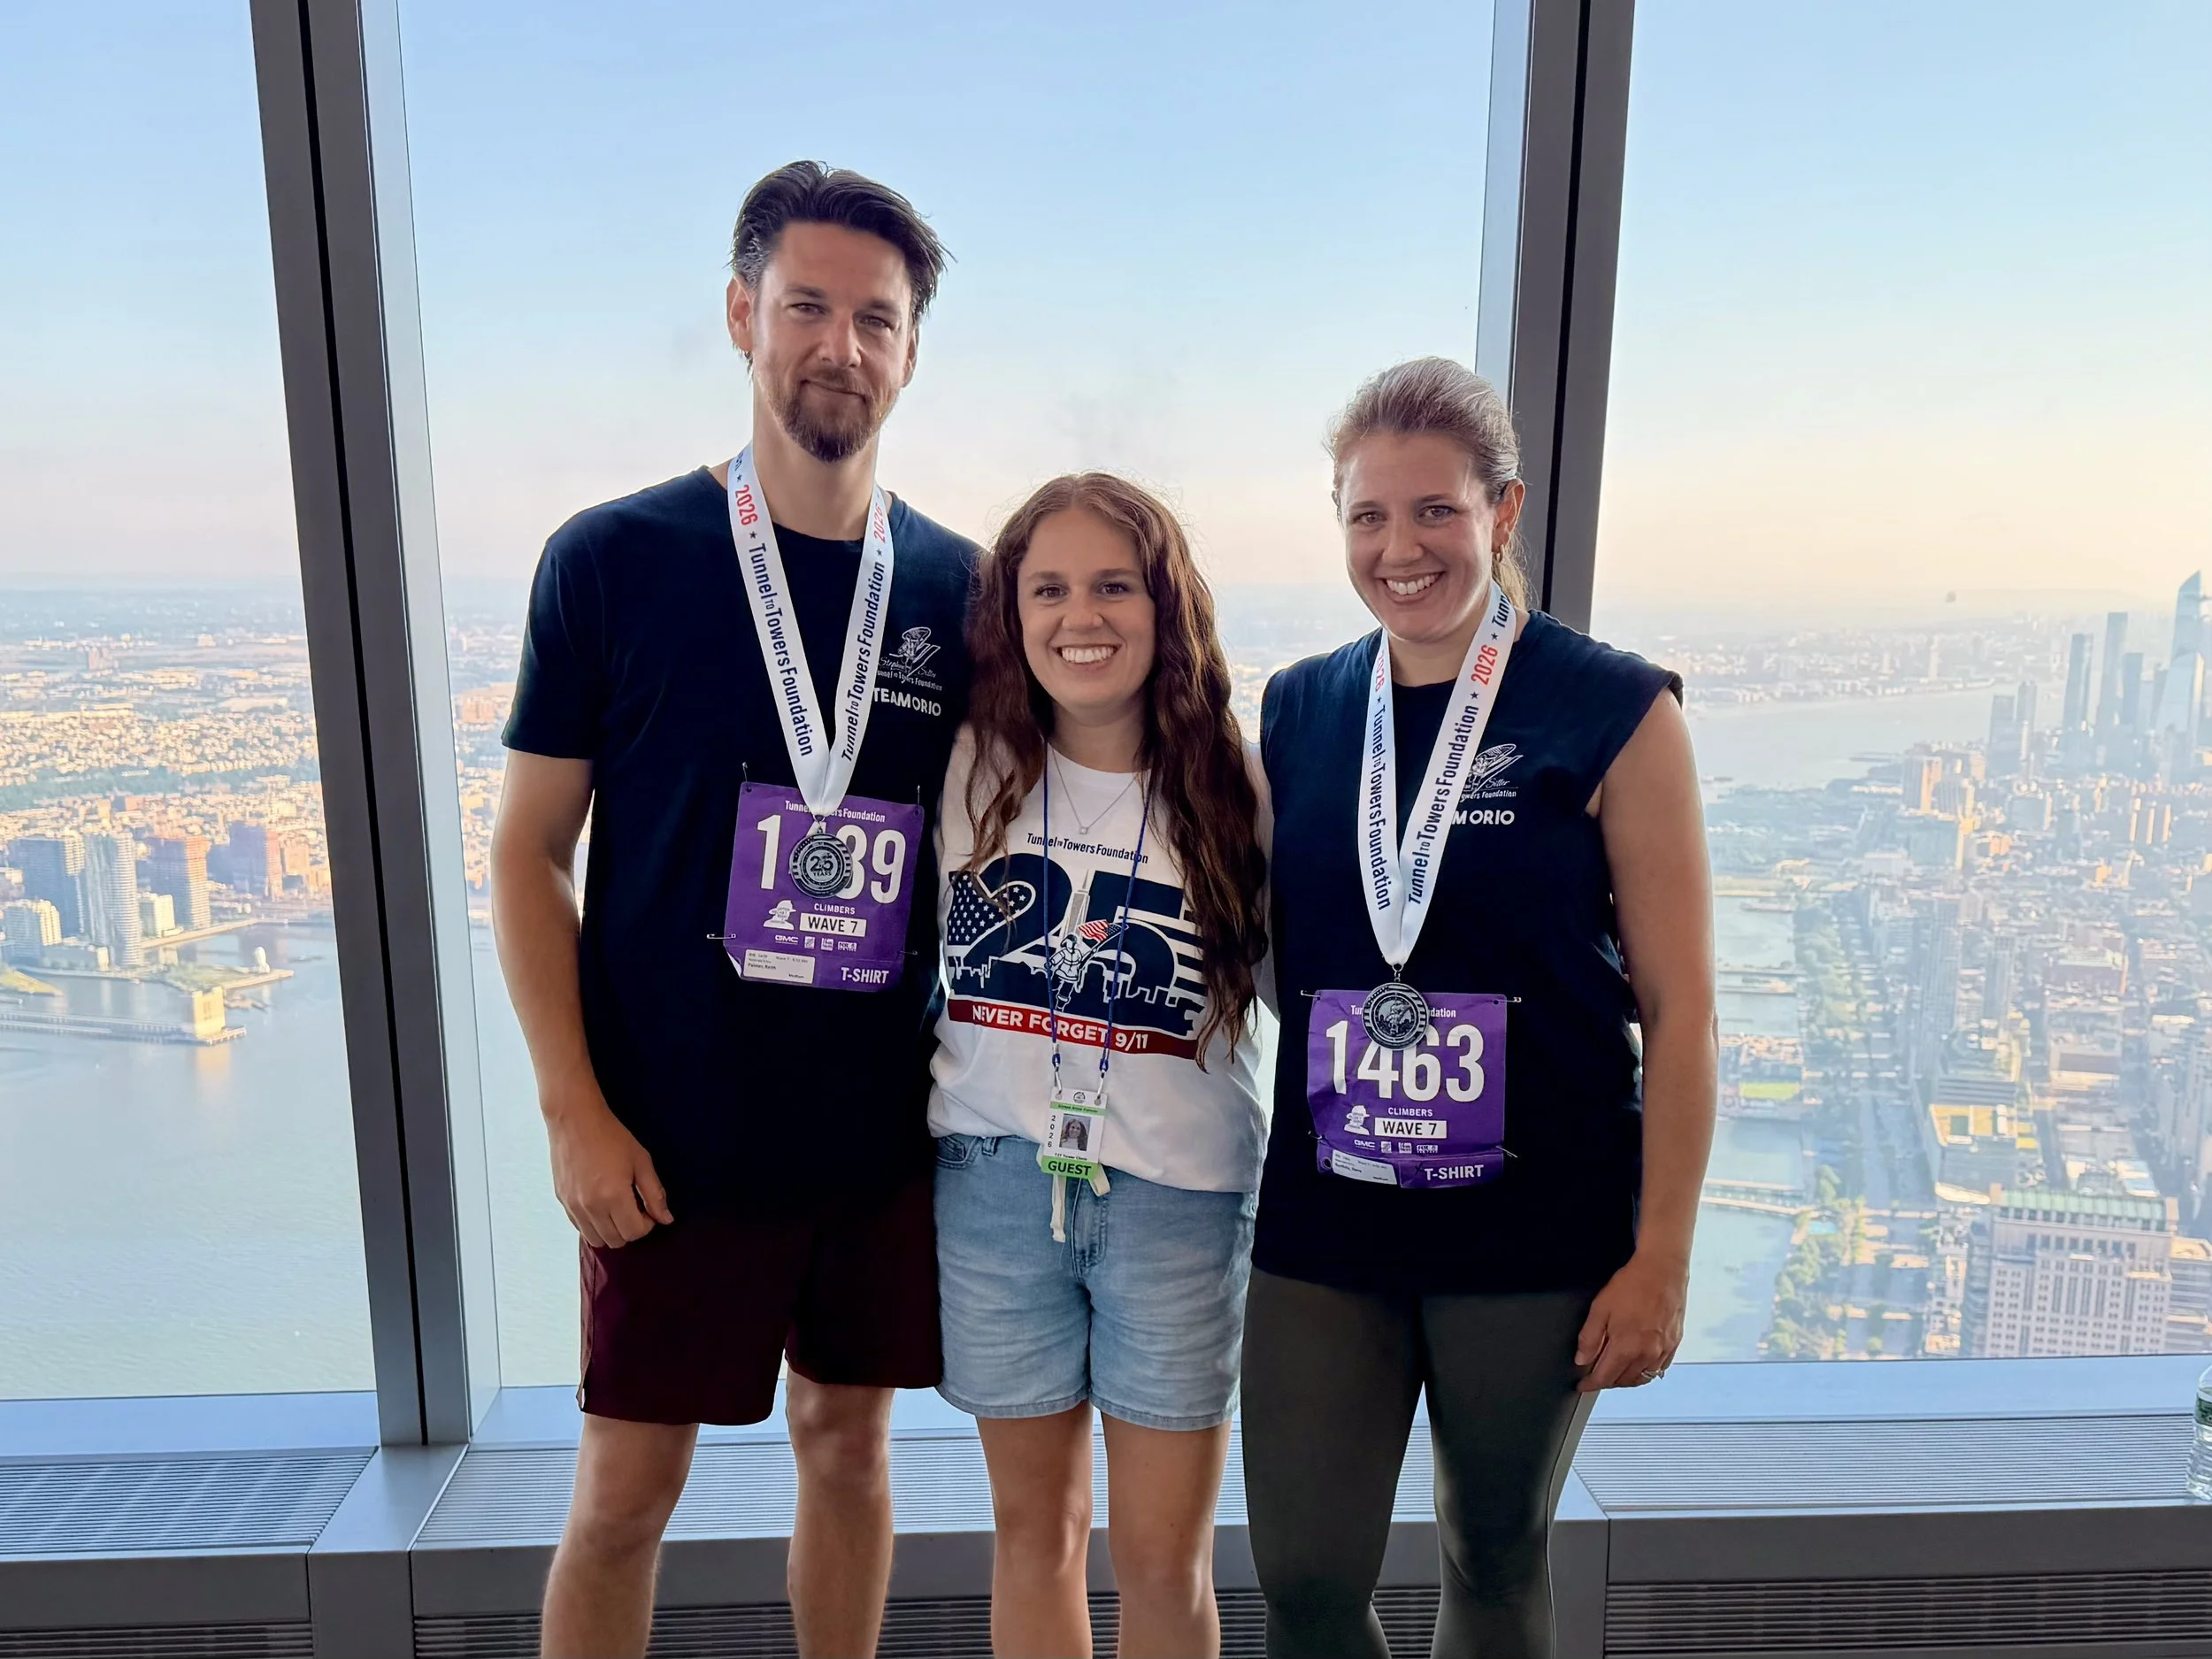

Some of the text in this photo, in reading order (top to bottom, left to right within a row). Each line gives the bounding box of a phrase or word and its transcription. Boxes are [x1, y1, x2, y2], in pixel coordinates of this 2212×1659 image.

[735, 484, 758, 526] 2026
[874, 503, 886, 543] 2026
[857, 561, 885, 647] Foundation
[749, 543, 813, 756] Tunnel TO Towers Foundation
[1471, 644, 1498, 686] 2026
[848, 648, 871, 702] Towers
[841, 709, 858, 762] Tunnel
[1372, 705, 1386, 761] Tunnel
[1436, 705, 1479, 787] Foundation
[786, 800, 810, 812] Tunne
[843, 808, 886, 822] Foundation
[1369, 763, 1386, 819] Towers
[1417, 787, 1450, 843] Towers
[1452, 810, 1515, 826] MORIO
[757, 814, 907, 903] 189
[1064, 838, 1095, 854] Towers
[1096, 844, 1148, 864] Foundation
[1369, 821, 1393, 910] Foundation
[1408, 851, 1431, 905] Tunnel
[808, 916, 858, 933] WAVE 7
[814, 902, 856, 915] CLIMBERS
[775, 934, 798, 943] GMC
[841, 966, 889, 984] T-SHIRT
[1029, 1013, 1109, 1043] FORGET
[1115, 1032, 1148, 1051] 9/11
[1428, 1007, 1456, 1018] dation
[1326, 1020, 1485, 1102] 1463
[1383, 1120, 1437, 1135] WAVE 7
[1387, 1107, 1433, 1117] CLIMBERS
[1048, 1160, 1092, 1176] GUEST
[1425, 1164, 1485, 1180] T-SHIRT
